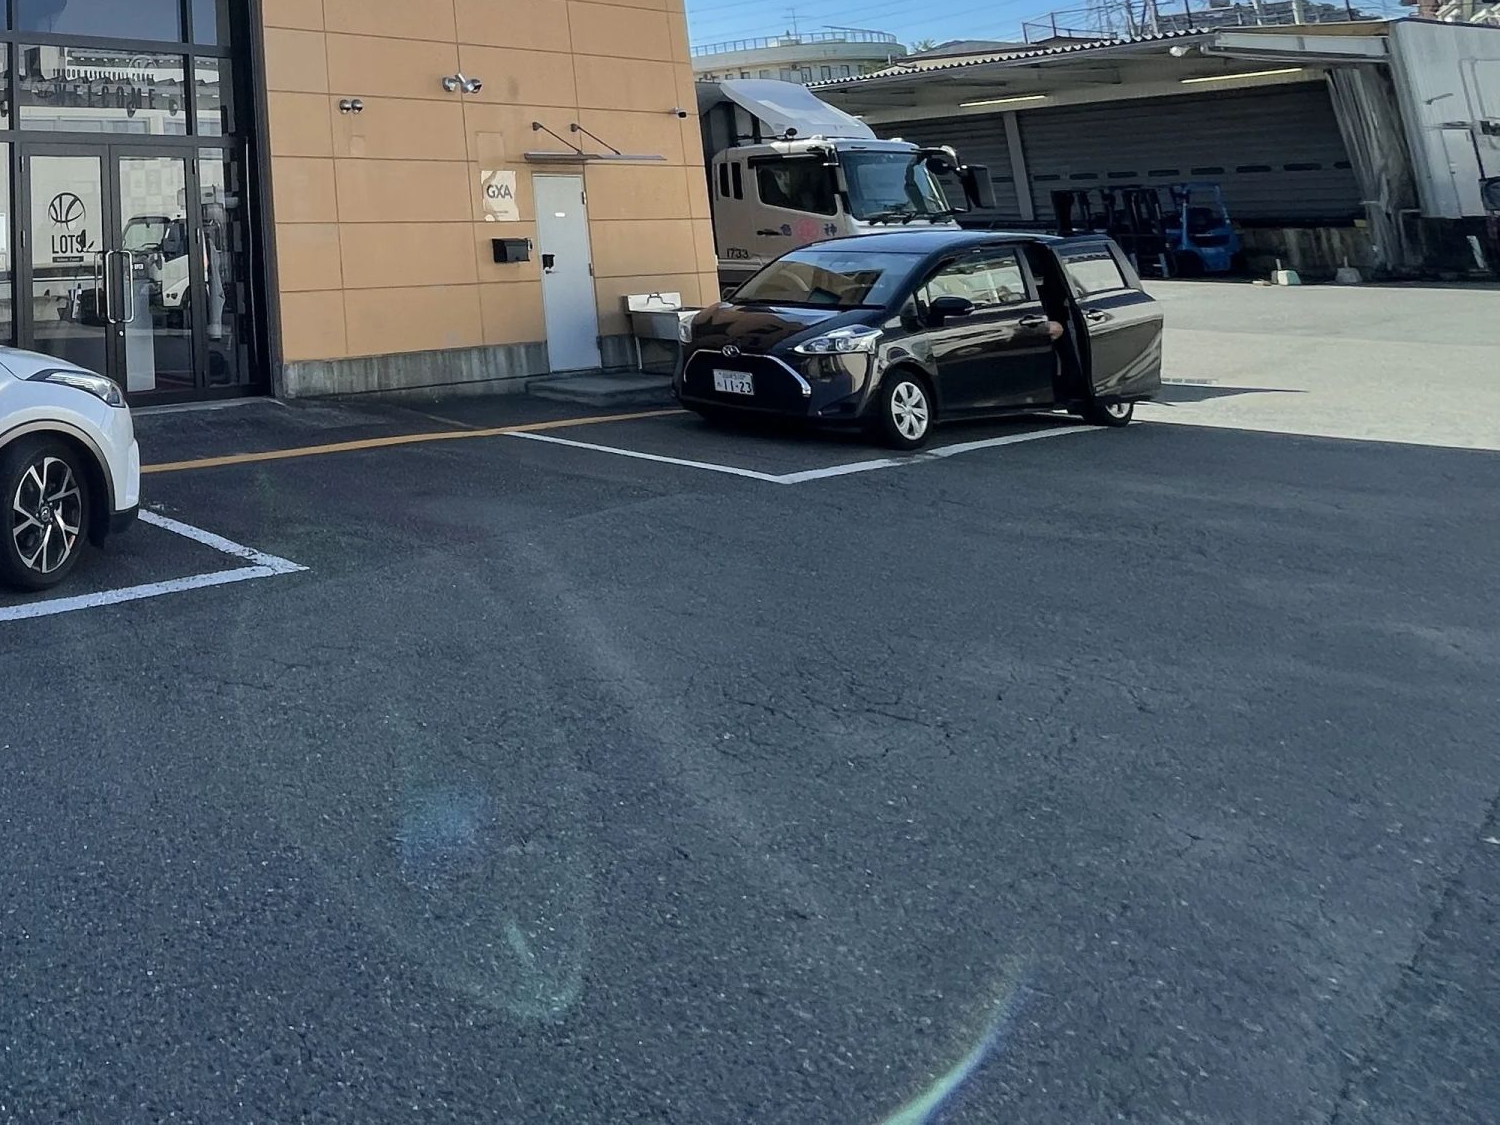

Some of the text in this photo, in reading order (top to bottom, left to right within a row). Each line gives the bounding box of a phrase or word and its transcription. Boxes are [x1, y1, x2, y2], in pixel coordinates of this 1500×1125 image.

[486, 184, 513, 199] GXA
[52, 235, 85, 254] LOTS
[726, 247, 749, 260] 1733
[723, 379, 752, 393] 11-23
